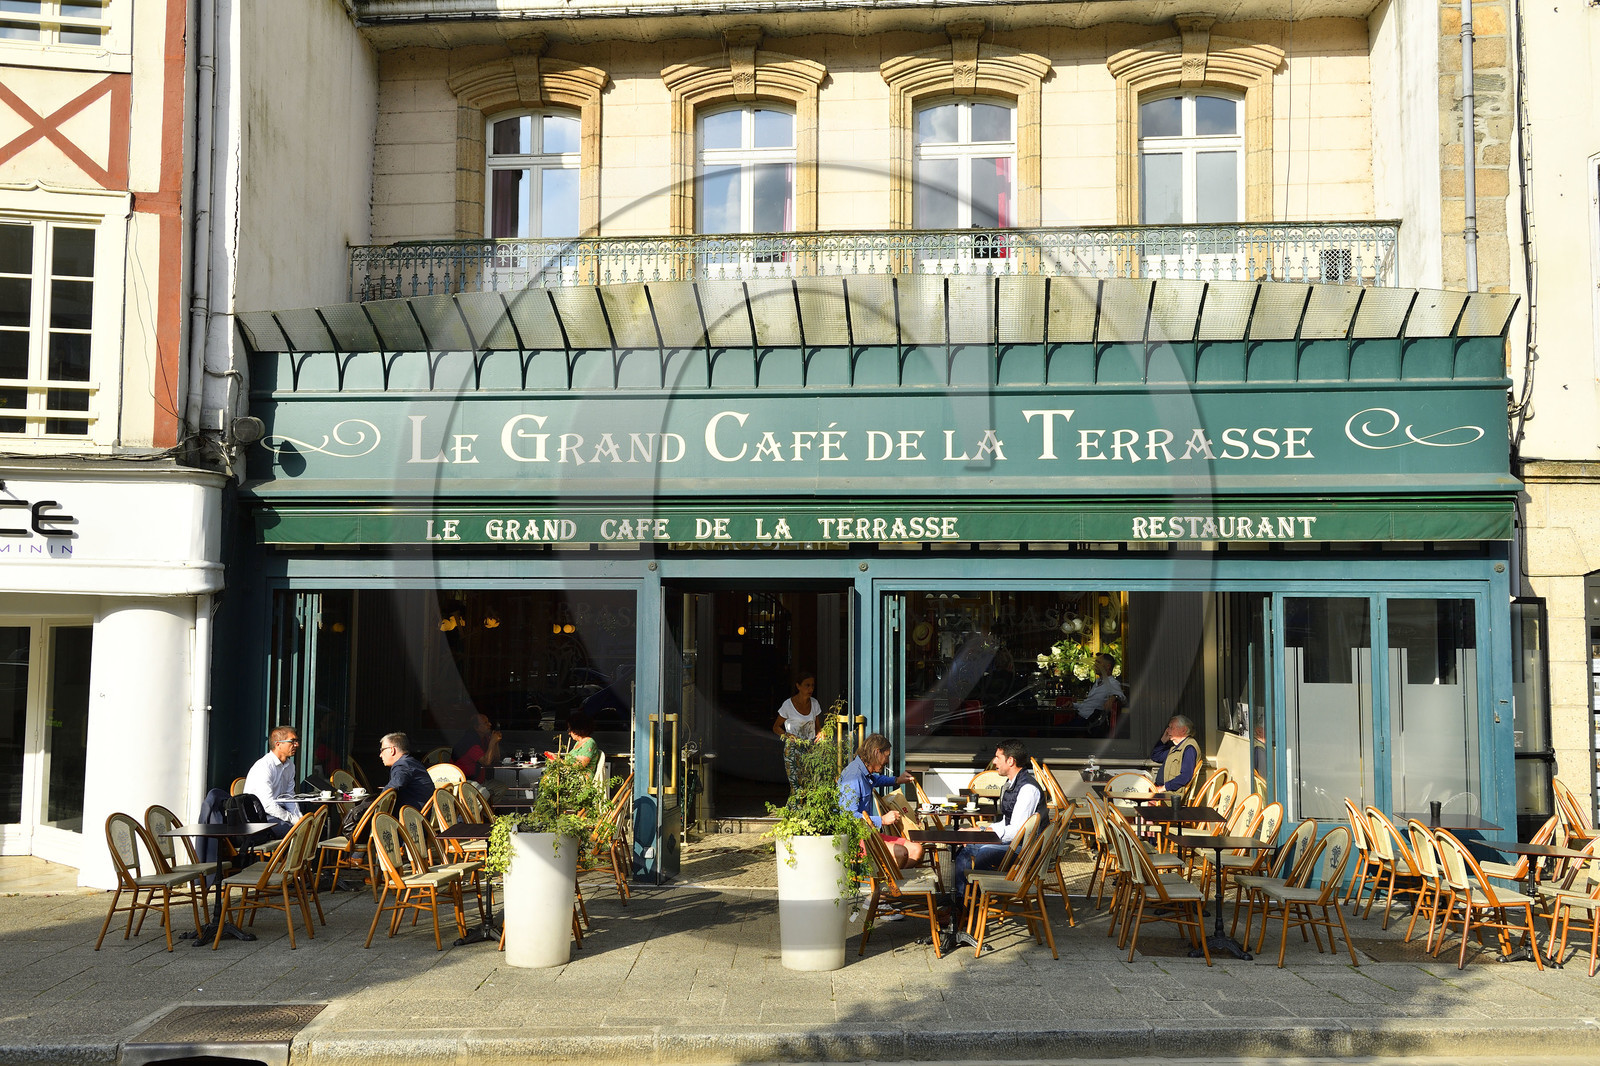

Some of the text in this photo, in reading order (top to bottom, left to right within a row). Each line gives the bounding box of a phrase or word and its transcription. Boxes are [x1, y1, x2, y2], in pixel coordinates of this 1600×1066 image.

[408, 409, 1315, 465] LE GRAND CAFÉ DE LA TERRASSE
[426, 516, 960, 542] LE GRAND CAFE DE LA TERRASSE
[1132, 516, 1317, 539] RESTAURANT
